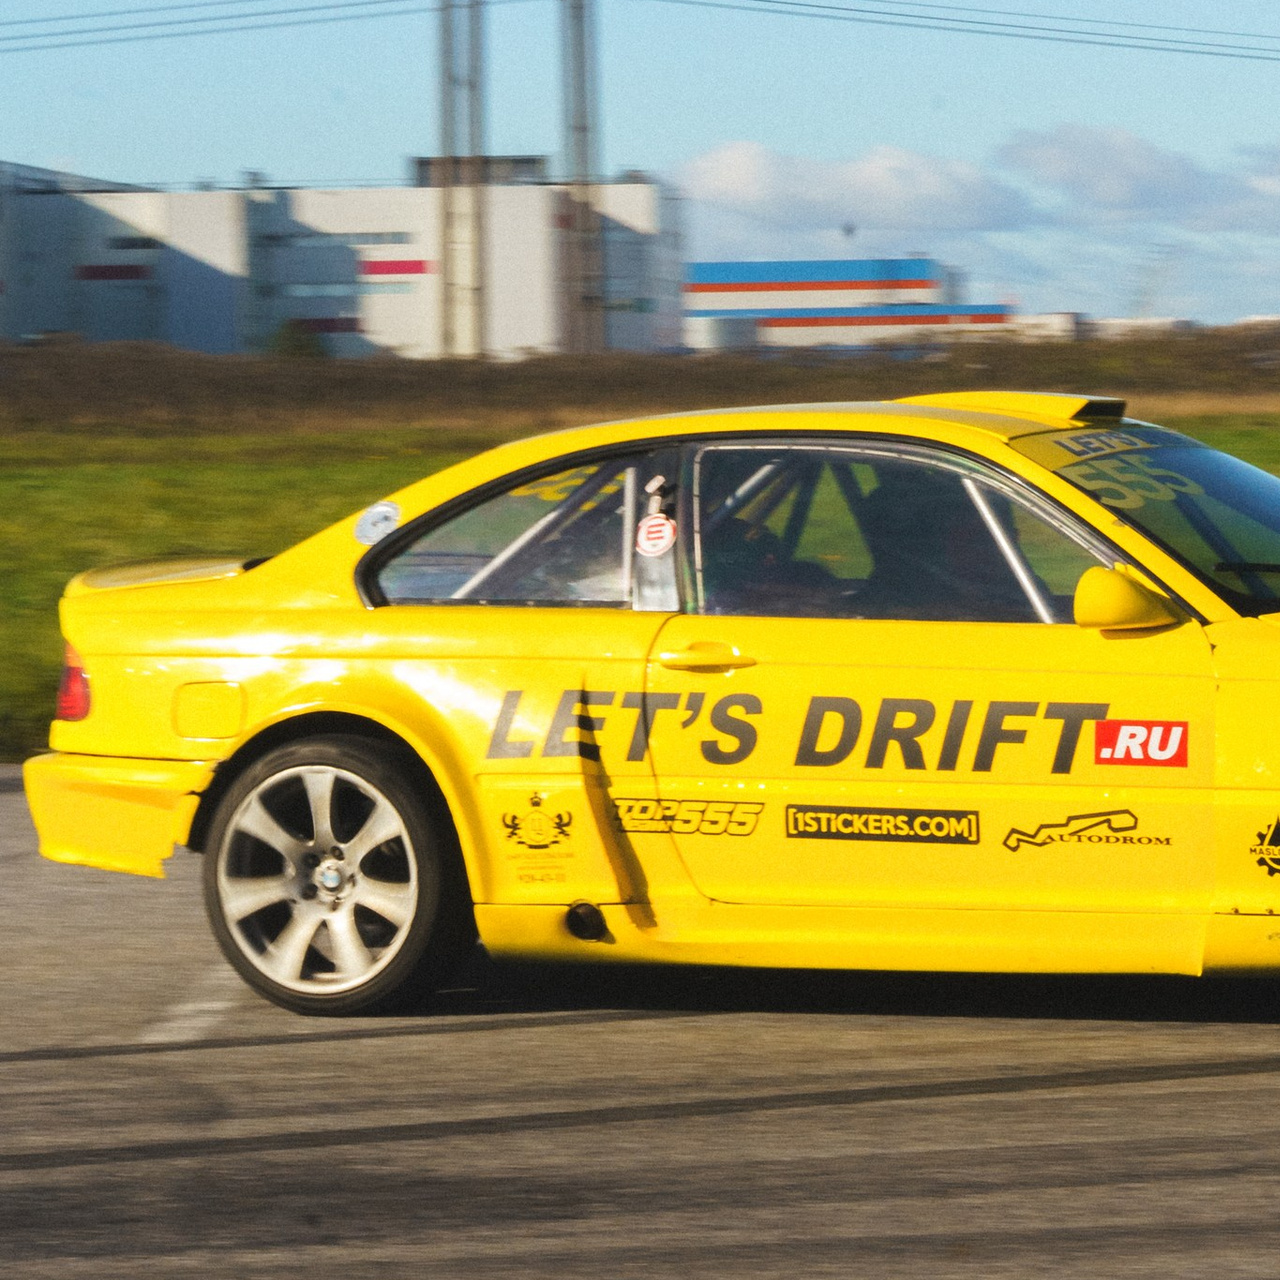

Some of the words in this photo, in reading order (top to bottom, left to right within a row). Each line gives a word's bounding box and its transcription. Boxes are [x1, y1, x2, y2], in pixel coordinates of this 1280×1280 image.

[485, 689, 764, 766] LET'S
[794, 696, 1110, 775] DRIFT
[1099, 726, 1183, 761] .RU
[1042, 833, 1173, 846] AUTODROM
